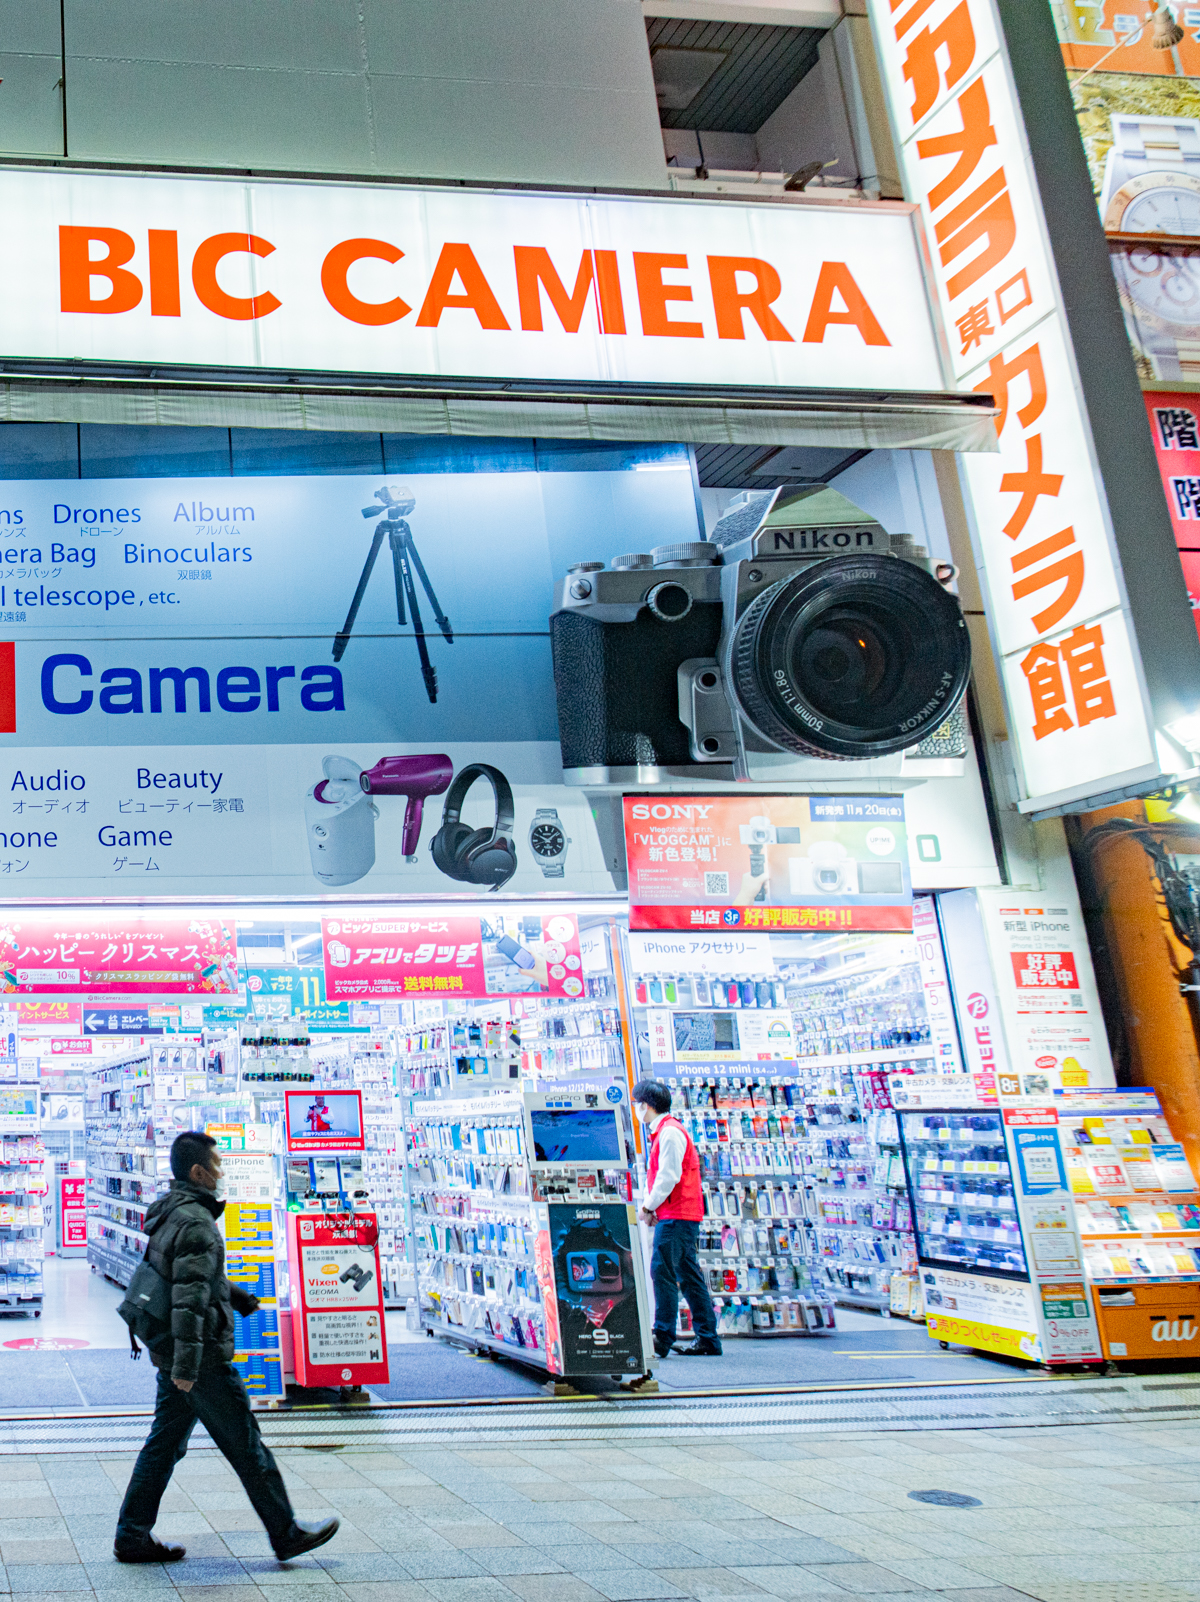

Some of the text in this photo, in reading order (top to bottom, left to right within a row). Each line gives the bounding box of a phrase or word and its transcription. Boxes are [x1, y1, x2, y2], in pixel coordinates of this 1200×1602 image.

[58, 225, 893, 348] BIC CAMERA
[955, 267, 1033, 357] 東口
[52, 503, 142, 524] Drones
[173, 501, 256, 522] Album
[79, 526, 124, 538] ドローン
[194, 525, 241, 536] アルバム
[774, 531, 874, 550] Nikon
[972, 341, 1117, 742] カメラ館
[51, 542, 97, 569] Bag
[124, 541, 253, 564] Binoculars
[177, 569, 213, 581] 双眼鏡
[842, 569, 877, 582] Nikon
[148, 590, 181, 605] etc.
[40, 653, 347, 716] Camera
[899, 696, 938, 733] NIKKOR
[10, 769, 87, 792] Audio
[136, 767, 224, 794] Beauty
[12, 799, 90, 814] オーディオ
[118, 798, 245, 814] ビューティー家電
[631, 803, 714, 820] SONY
[814, 805, 844, 816] 新発売
[98, 825, 173, 848] Game
[112, 857, 160, 872] ゲーム
[690, 909, 720, 925] 当店
[342, 922, 449, 933] ビック SUPER サービス
[1003, 920, 1071, 932] 新型 iPhone
[17, 942, 201, 963] ハッピー クリスマス
[353, 942, 479, 965] アプリでタッチ
[643, 941, 757, 954] iPhone アクセサリー
[1026, 953, 1063, 970] 好評
[56, 970, 76, 980] 10%
[403, 975, 464, 991] 送料無料
[1020, 969, 1074, 986] 販売中
[270, 983, 293, 991] ずっと
[255, 1003, 287, 1014] おトク
[655, 1025, 667, 1059] 検温中
[675, 1064, 752, 1075] iPhone 12 mini
[1001, 1077, 1020, 1094] 8F
[308, 1278, 338, 1287] Vixen
[309, 1288, 340, 1296] GEOMA
[592, 1328, 609, 1346] 9
[938, 1318, 1019, 1347] 売りつくしセール
[1151, 1319, 1199, 1342] au
